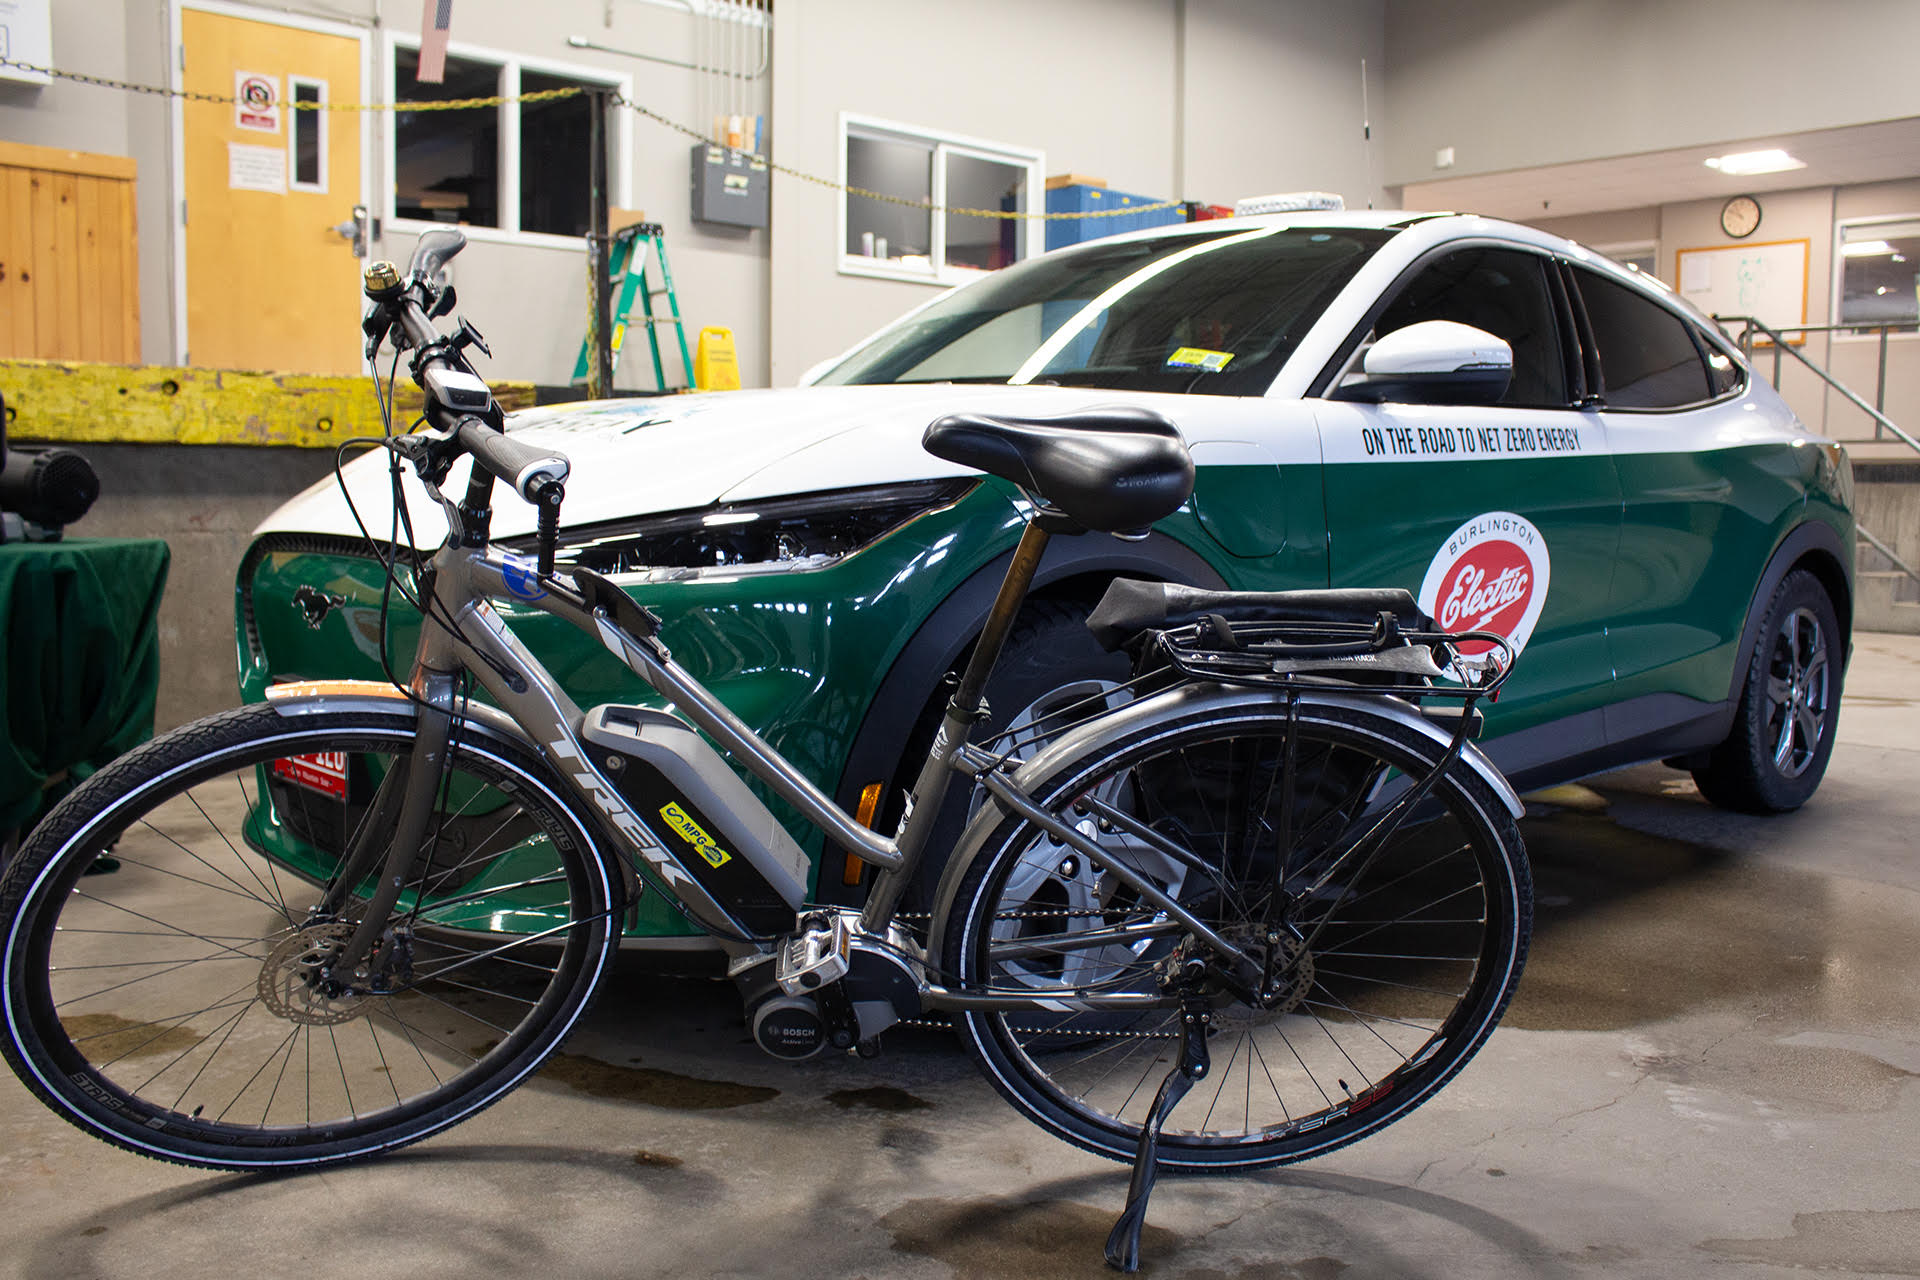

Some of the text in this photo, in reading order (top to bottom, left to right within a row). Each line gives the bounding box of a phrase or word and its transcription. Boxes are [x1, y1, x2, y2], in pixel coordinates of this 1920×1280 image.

[1362, 427, 1582, 455] ON THE ROAD TO NET ZERO ENERGY
[1449, 519, 1535, 556] BURLINGTON
[1441, 564, 1528, 630] Electric
[550, 723, 694, 888] TREK
[682, 822, 708, 845] MPG
[783, 1028, 815, 1037] BOSCH
[70, 1072, 125, 1111] STANS
